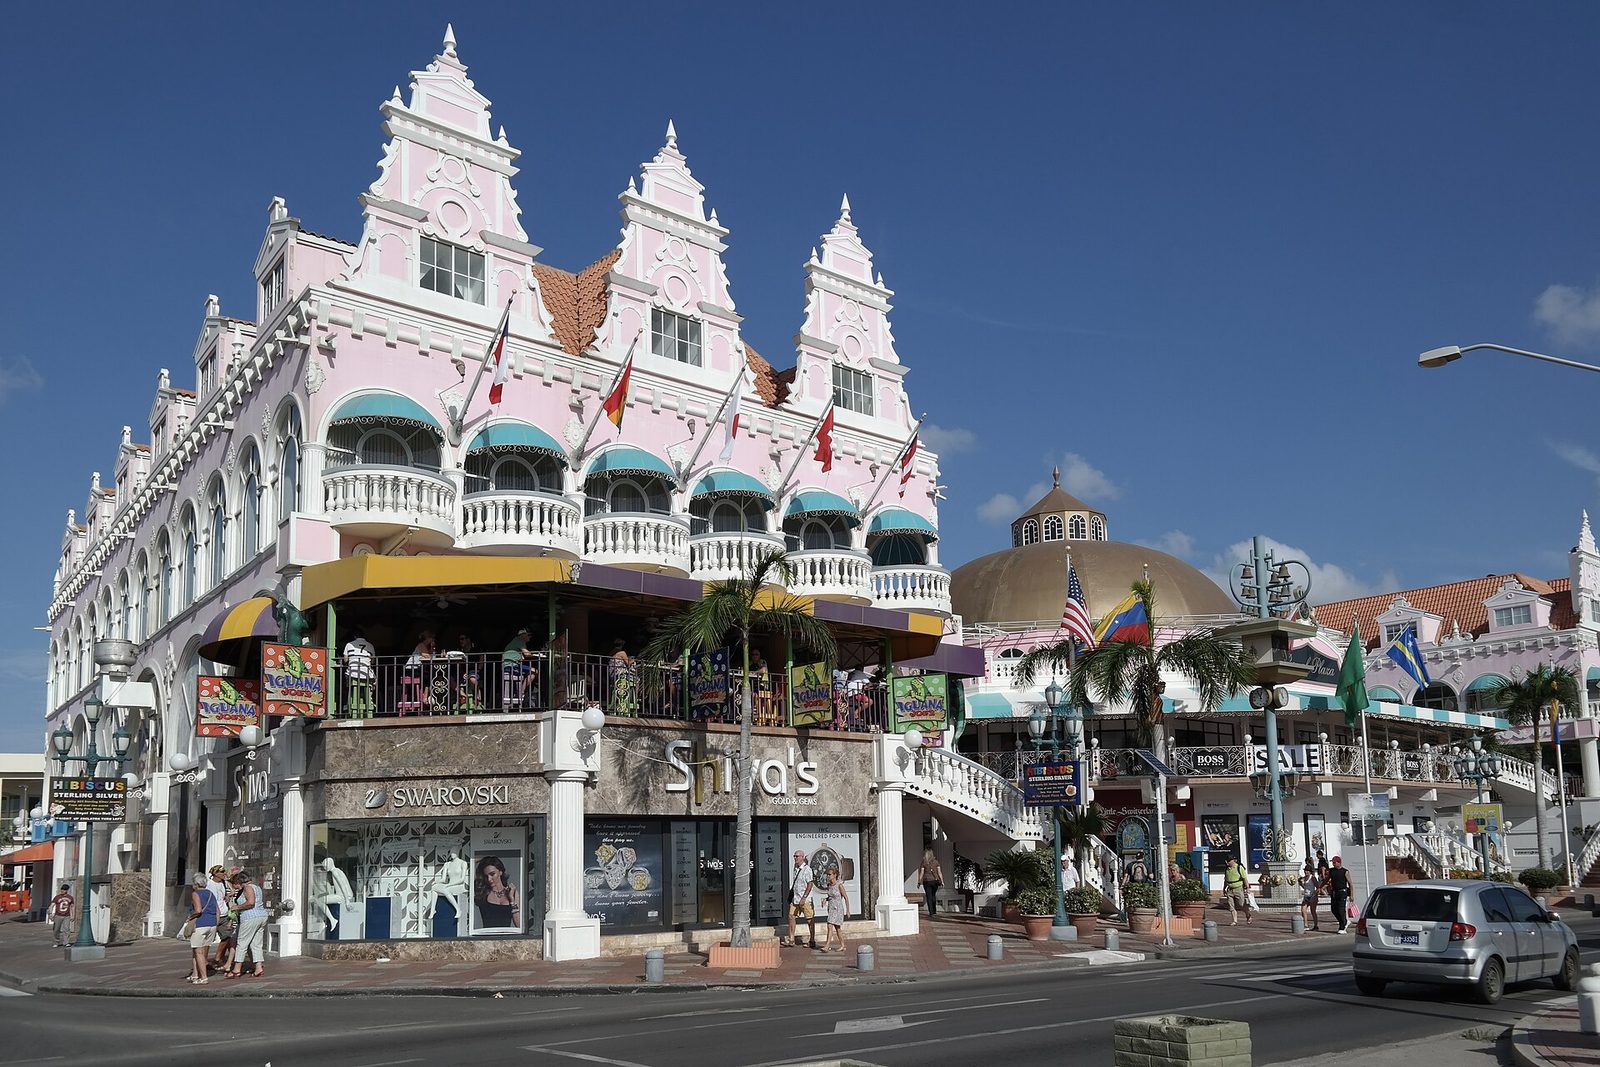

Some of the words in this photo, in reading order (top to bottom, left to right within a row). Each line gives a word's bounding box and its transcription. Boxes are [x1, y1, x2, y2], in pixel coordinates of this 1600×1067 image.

[359, 644, 366, 653] 7
[266, 673, 321, 692] IGUANA
[692, 679, 726, 694] IGUANA
[794, 688, 829, 702] IGUANA
[203, 701, 256, 716] IGUANA
[896, 699, 944, 713] IGUANA
[1197, 755, 1224, 763] BOSS
[1027, 765, 1074, 777] HIBISCUS
[53, 781, 124, 791] HIBISCUS
[394, 786, 509, 807] SWAROVSKI
[772, 797, 790, 805] GOLD
[792, 797, 798, 805] &
[799, 797, 817, 806] GEMS
